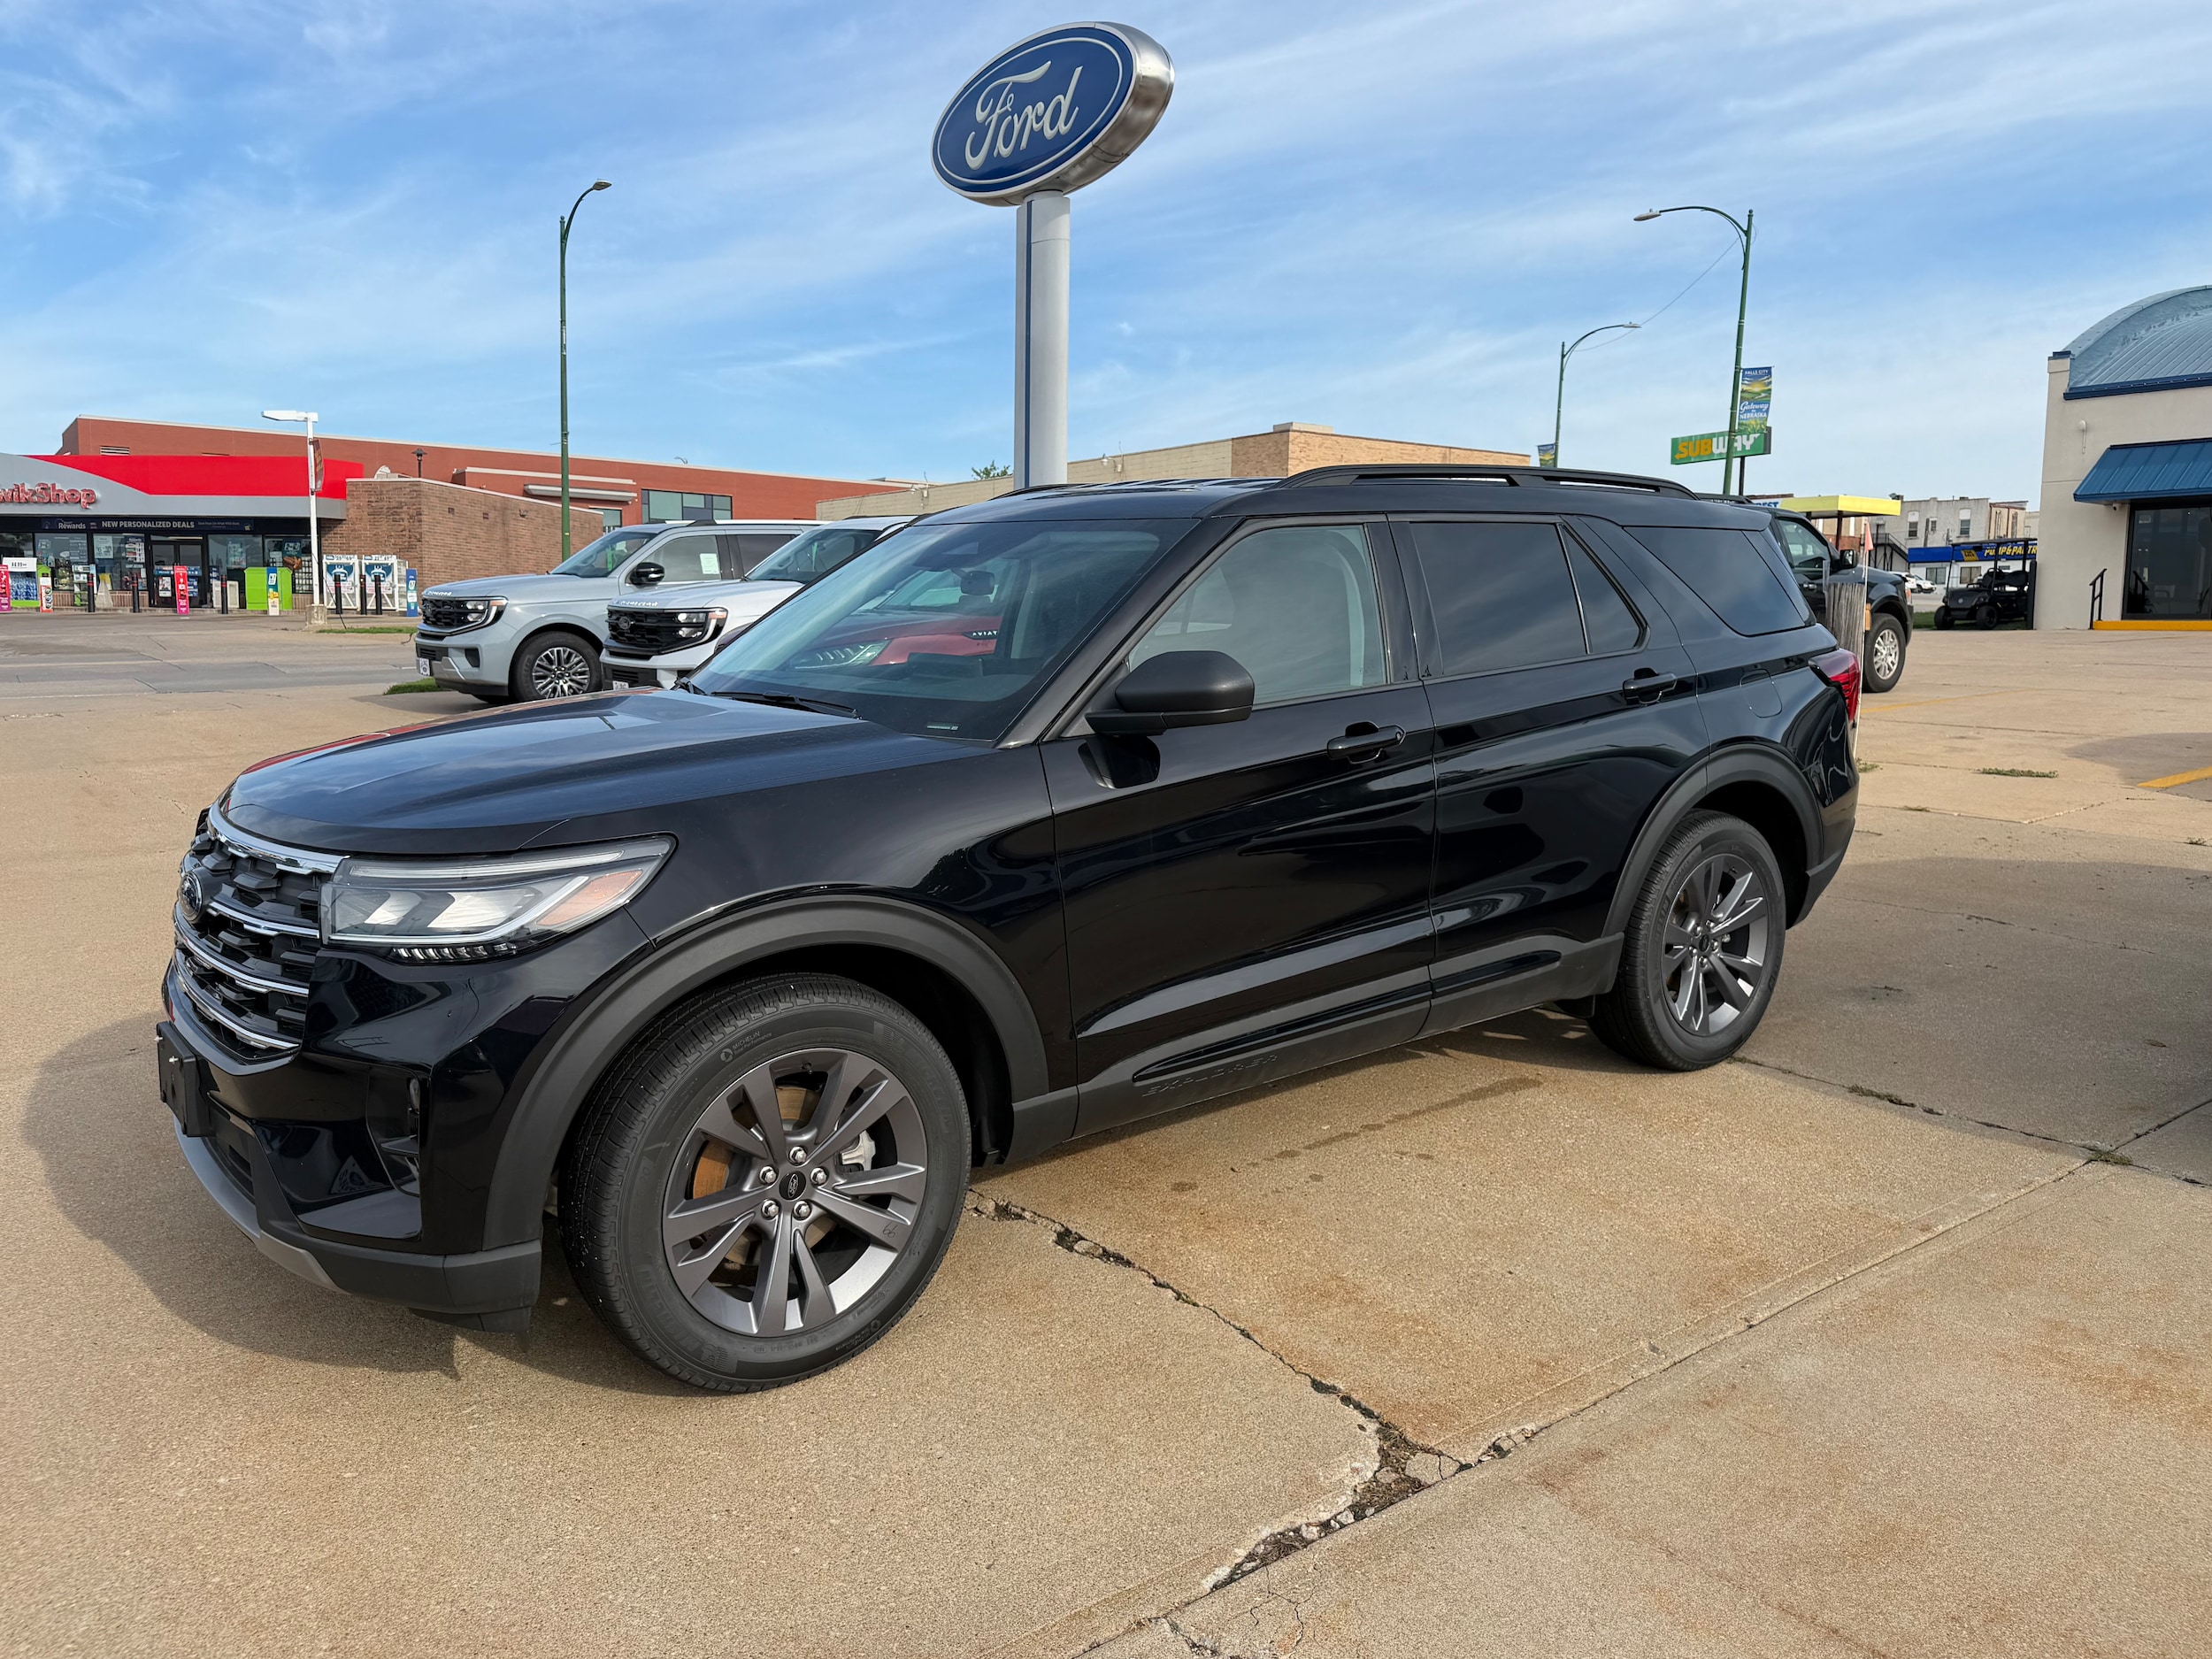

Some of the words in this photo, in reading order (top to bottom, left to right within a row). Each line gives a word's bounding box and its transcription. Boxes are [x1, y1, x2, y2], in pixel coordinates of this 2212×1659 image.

[965, 60, 1083, 170] Ford
[1740, 401, 1769, 413] Gateway
[1675, 434, 1761, 460] SUBWAY
[732, 1030, 760, 1050] MICHELIN
